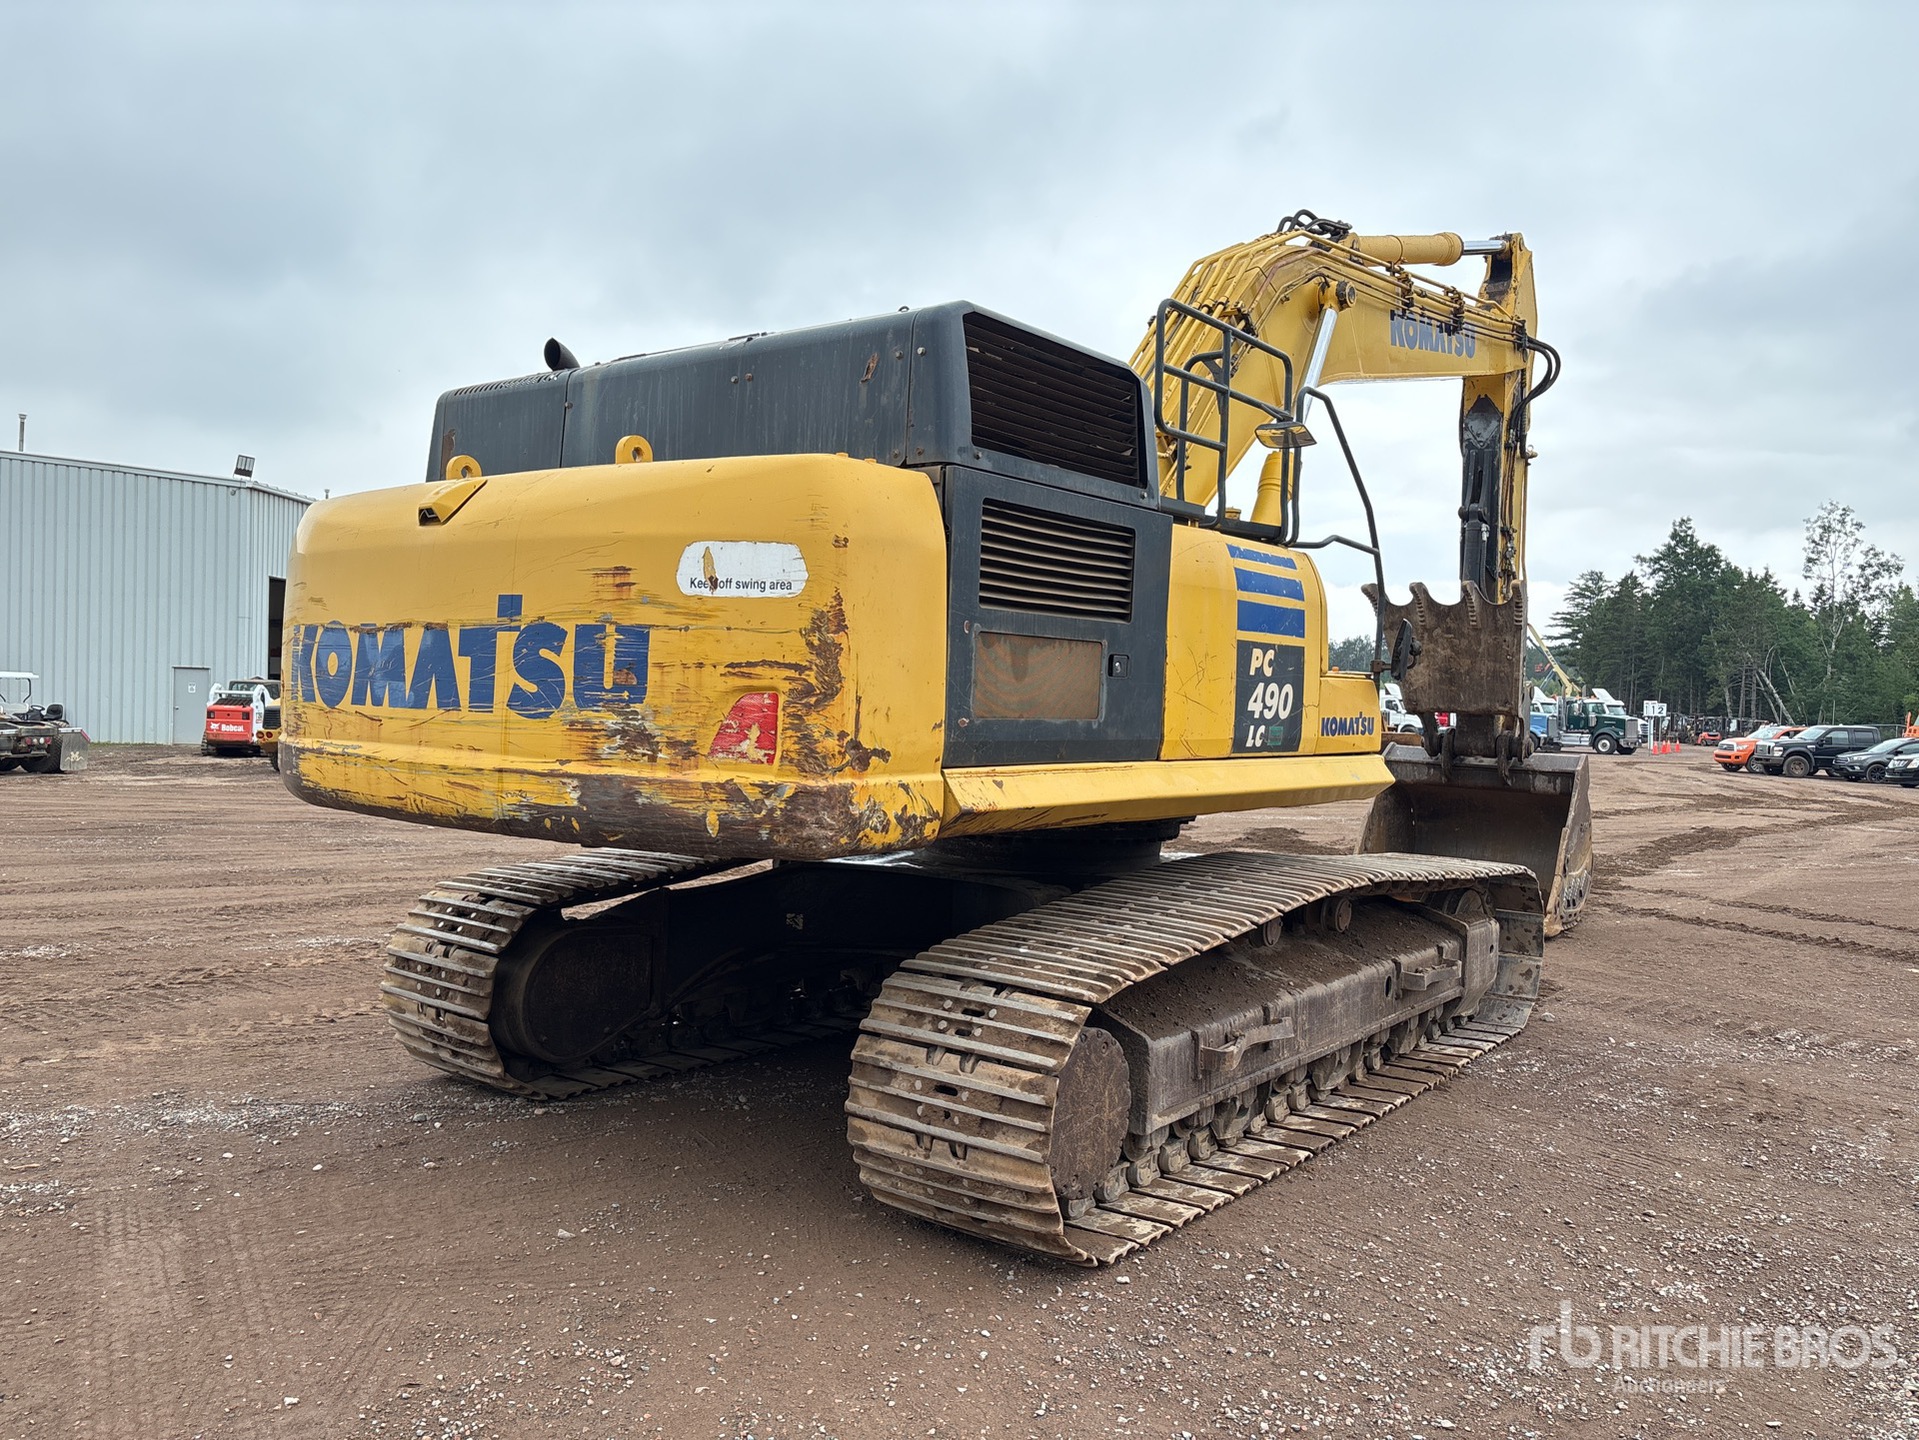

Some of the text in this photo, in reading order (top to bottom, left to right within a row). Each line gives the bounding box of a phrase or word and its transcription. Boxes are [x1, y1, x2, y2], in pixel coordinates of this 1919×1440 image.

[690, 577, 793, 593] Kee off swing area
[291, 594, 650, 719] KOMATSU
[1250, 648, 1275, 677] PC
[1247, 682, 1294, 720] 490
[221, 723, 244, 732] Bobcat
[1245, 725, 1266, 747] LC
[1320, 711, 1375, 737] KOMATSU
